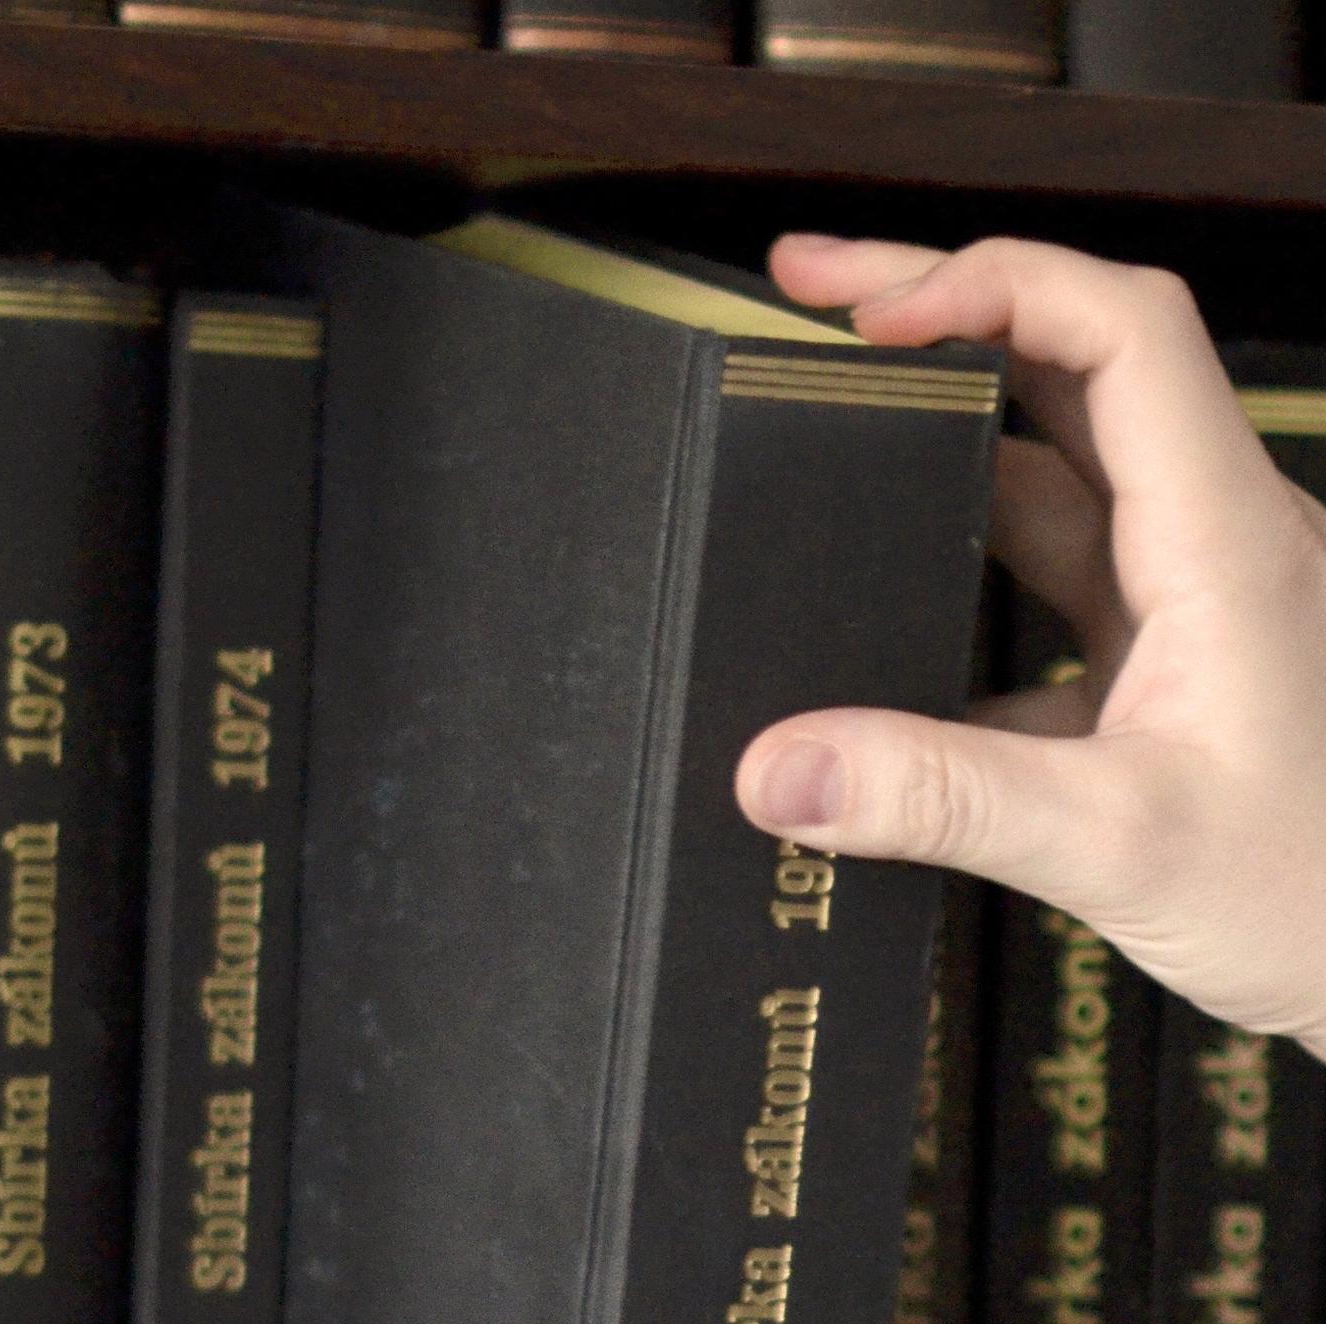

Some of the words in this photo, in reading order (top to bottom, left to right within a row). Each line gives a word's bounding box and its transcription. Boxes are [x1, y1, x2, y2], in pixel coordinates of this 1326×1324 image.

[5, 622, 67, 764] 1973
[212, 648, 273, 789] 1974
[201, 842, 265, 1065] zákonů
[191, 1091, 253, 1291] Sbírka
[745, 987, 821, 1218] zákonů
